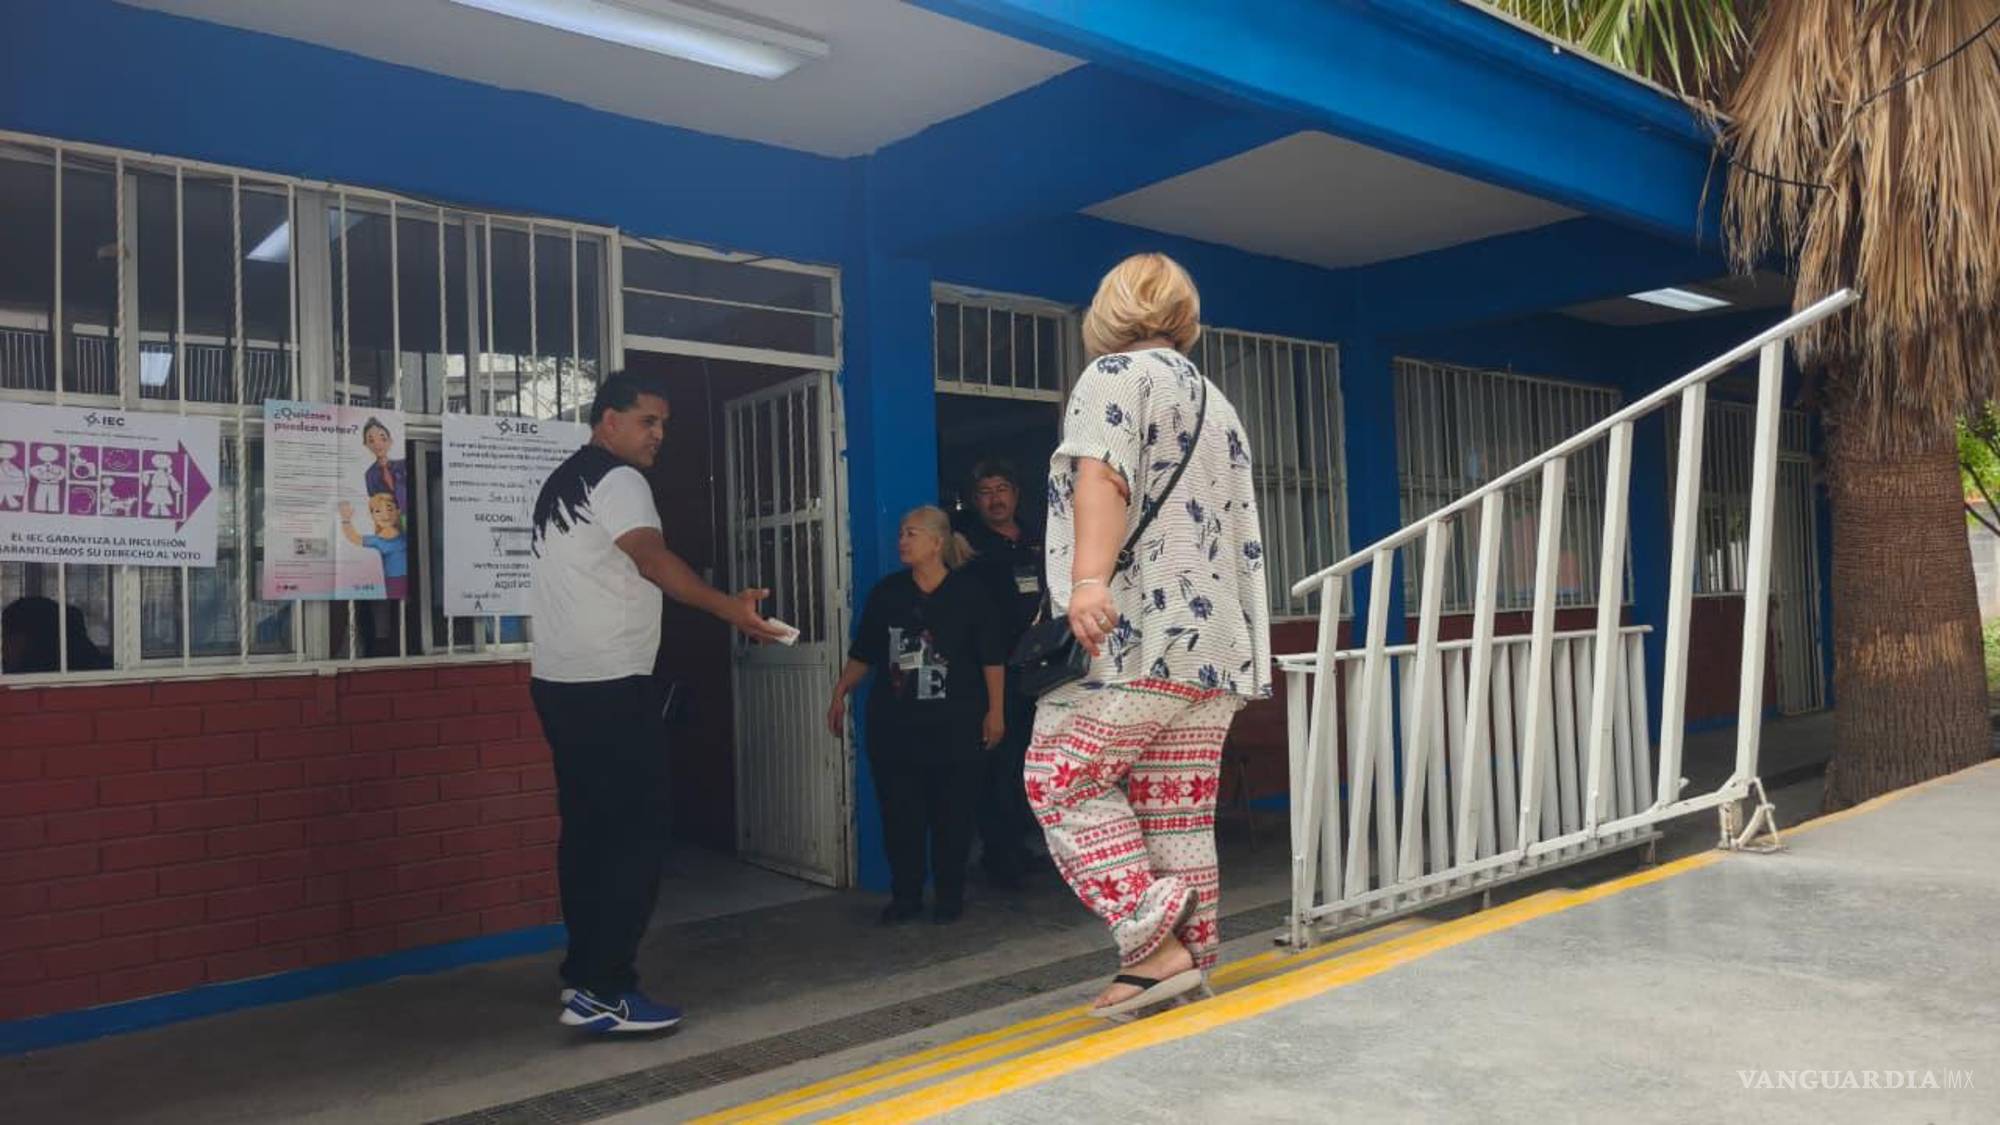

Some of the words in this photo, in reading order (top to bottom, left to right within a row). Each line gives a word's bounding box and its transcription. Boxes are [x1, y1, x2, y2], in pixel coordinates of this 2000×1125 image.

[102, 416, 125, 426] IEC
[274, 421, 318, 433] pueden
[321, 424, 359, 435] votar?
[515, 423, 538, 434] IEC
[11, 532, 23, 542] EL
[46, 534, 110, 546] GARANTIZA
[113, 536, 126, 546] LA
[86, 547, 101, 557] SU
[104, 548, 154, 560] DERECHO
[156, 550, 169, 560] AL
[172, 551, 201, 561] VOTO
